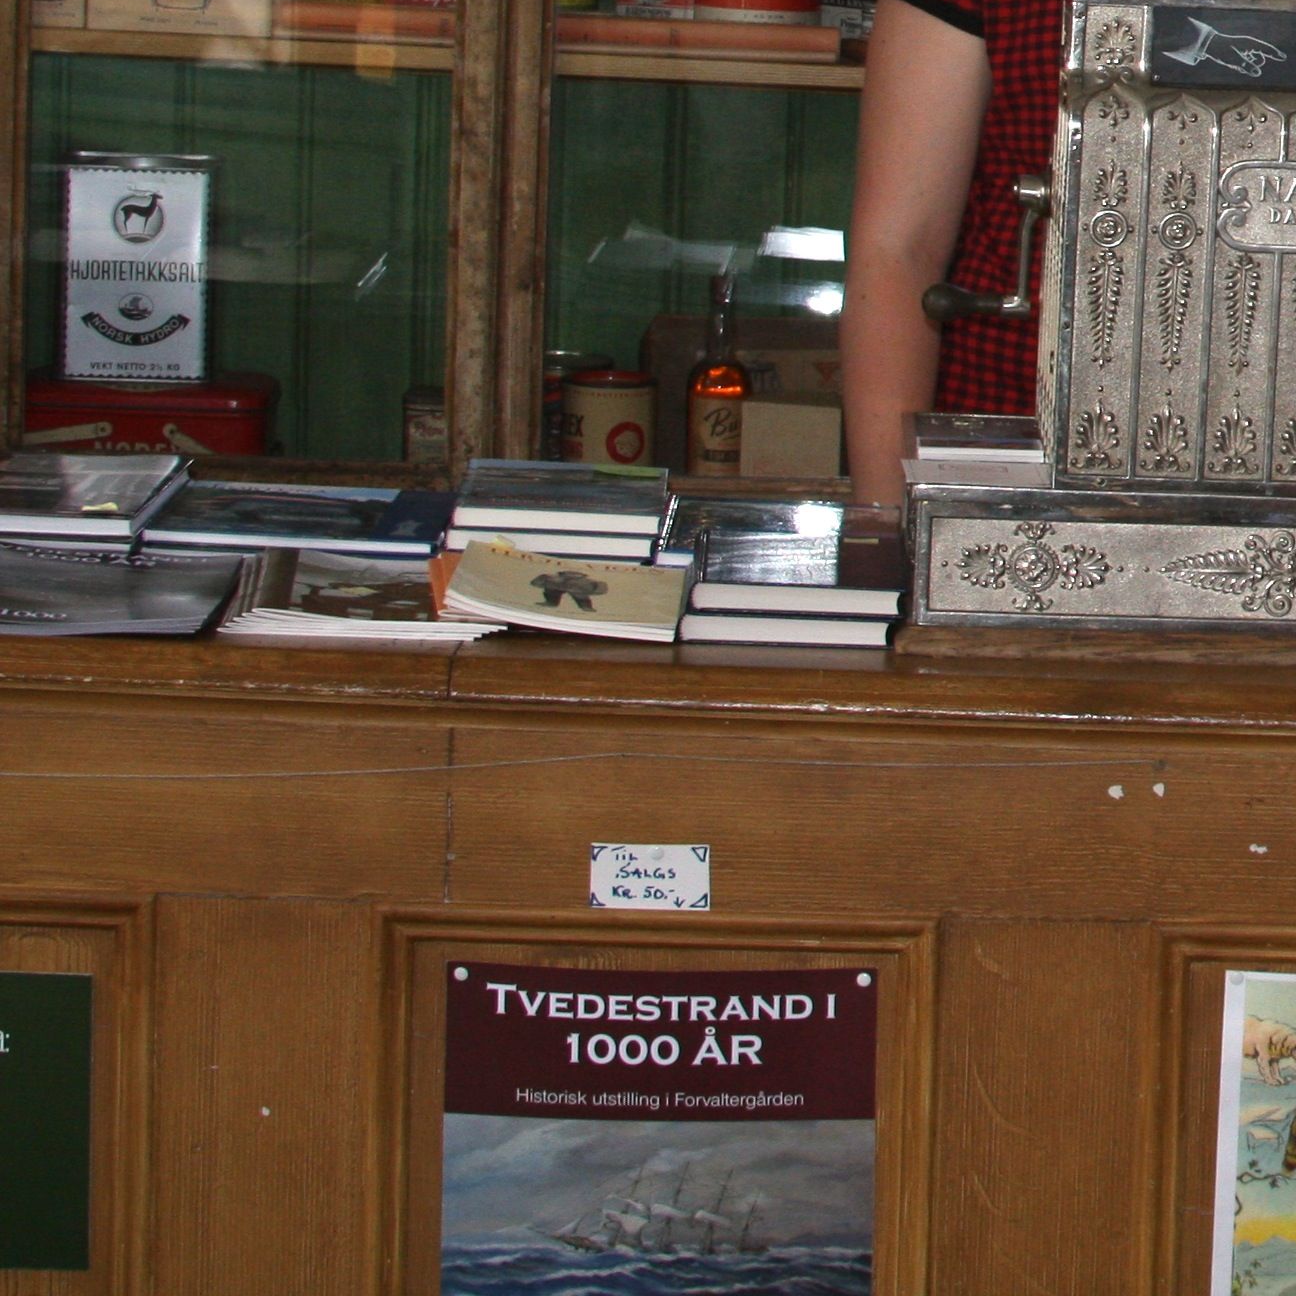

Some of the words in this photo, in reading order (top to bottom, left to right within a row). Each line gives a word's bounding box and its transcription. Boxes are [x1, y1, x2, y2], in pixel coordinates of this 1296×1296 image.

[70, 259, 205, 284] HJORTETAKKSALT
[91, 315, 133, 345] NORSK
[139, 317, 181, 346] HYDRO
[90, 361, 113, 371] VEKT
[117, 361, 147, 371] NETTO
[166, 361, 181, 372] KG
[702, 407, 741, 439] Bu
[485, 981, 815, 1023] TVEDESTRAND
[825, 993, 838, 1020] I
[566, 1032, 680, 1066] 1000
[691, 1026, 764, 1066] ÅR
[515, 1086, 588, 1106] Historisk
[592, 1090, 661, 1110] utstilling
[664, 1091, 670, 1107] i
[674, 1090, 805, 1111] Forvaltergården
